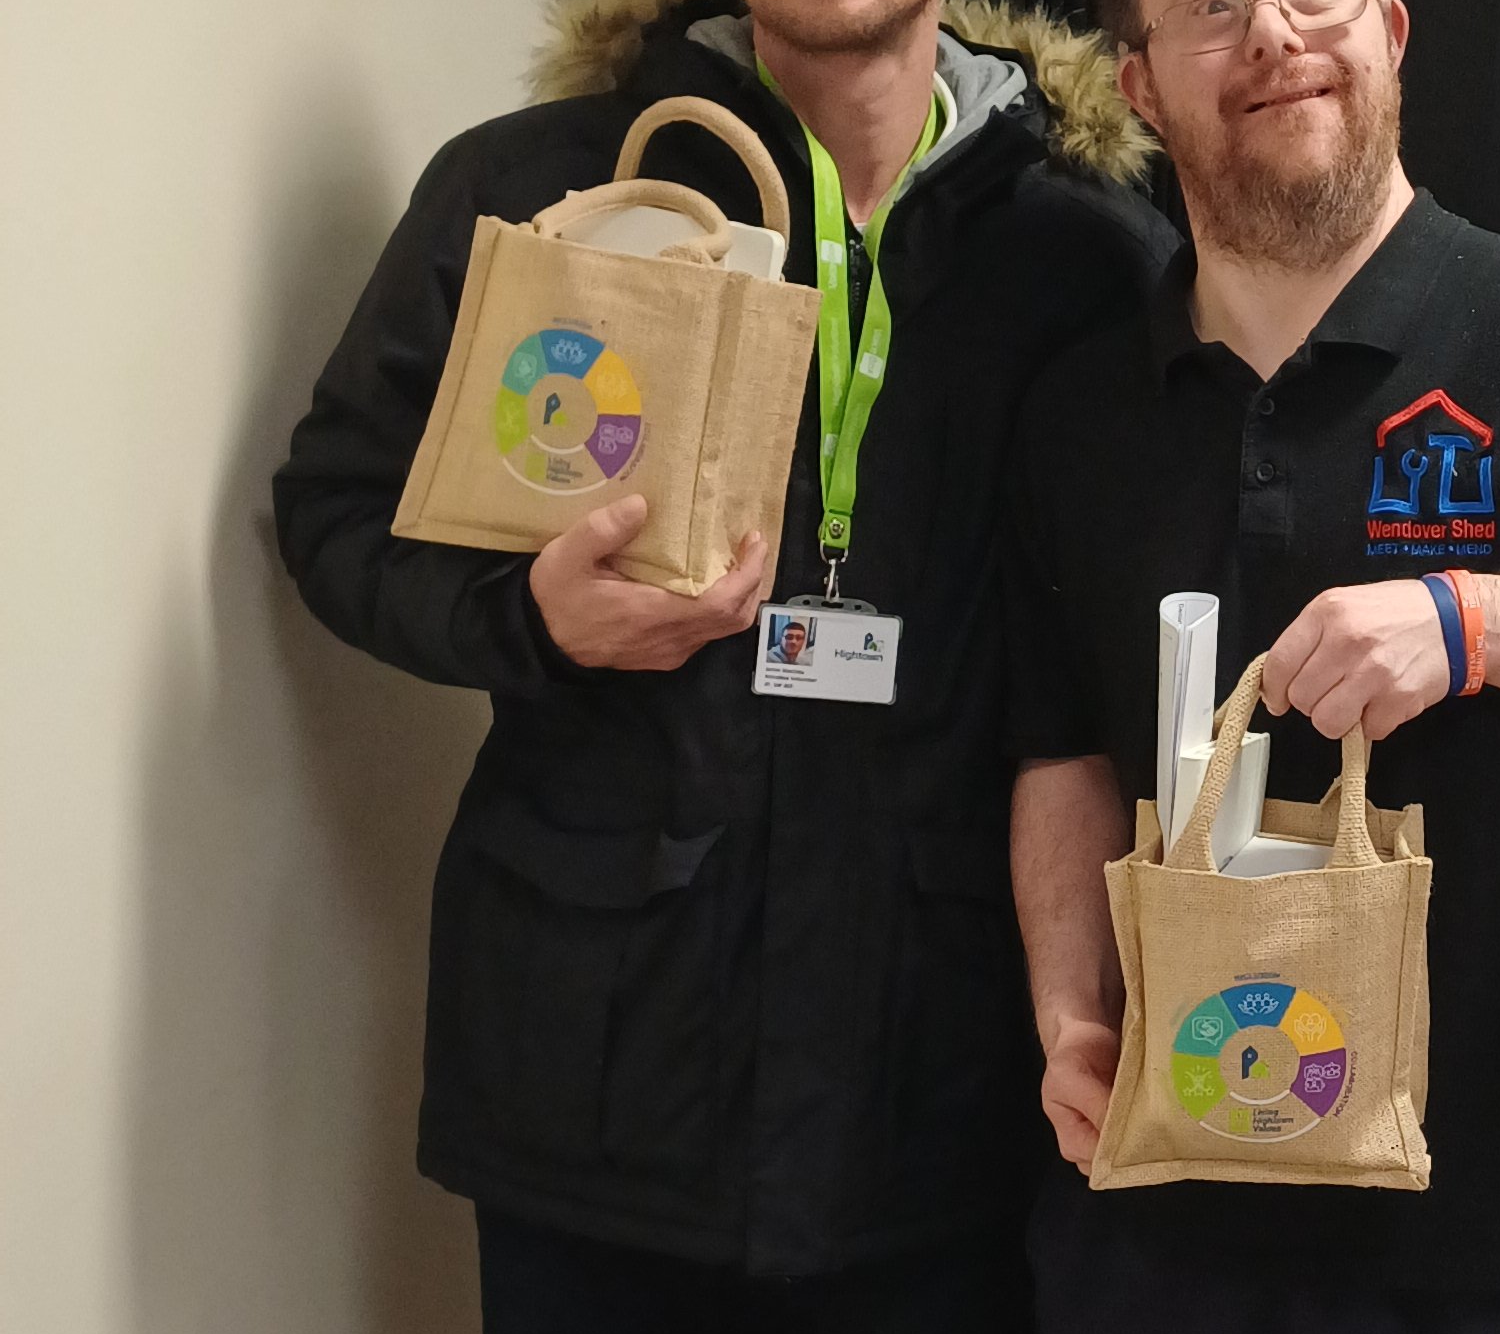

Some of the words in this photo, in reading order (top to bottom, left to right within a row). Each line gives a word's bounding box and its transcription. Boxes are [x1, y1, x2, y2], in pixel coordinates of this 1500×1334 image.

[1366, 519, 1448, 539] Wendover
[1451, 519, 1496, 539] Shed
[1411, 543, 1445, 556] MAKE
